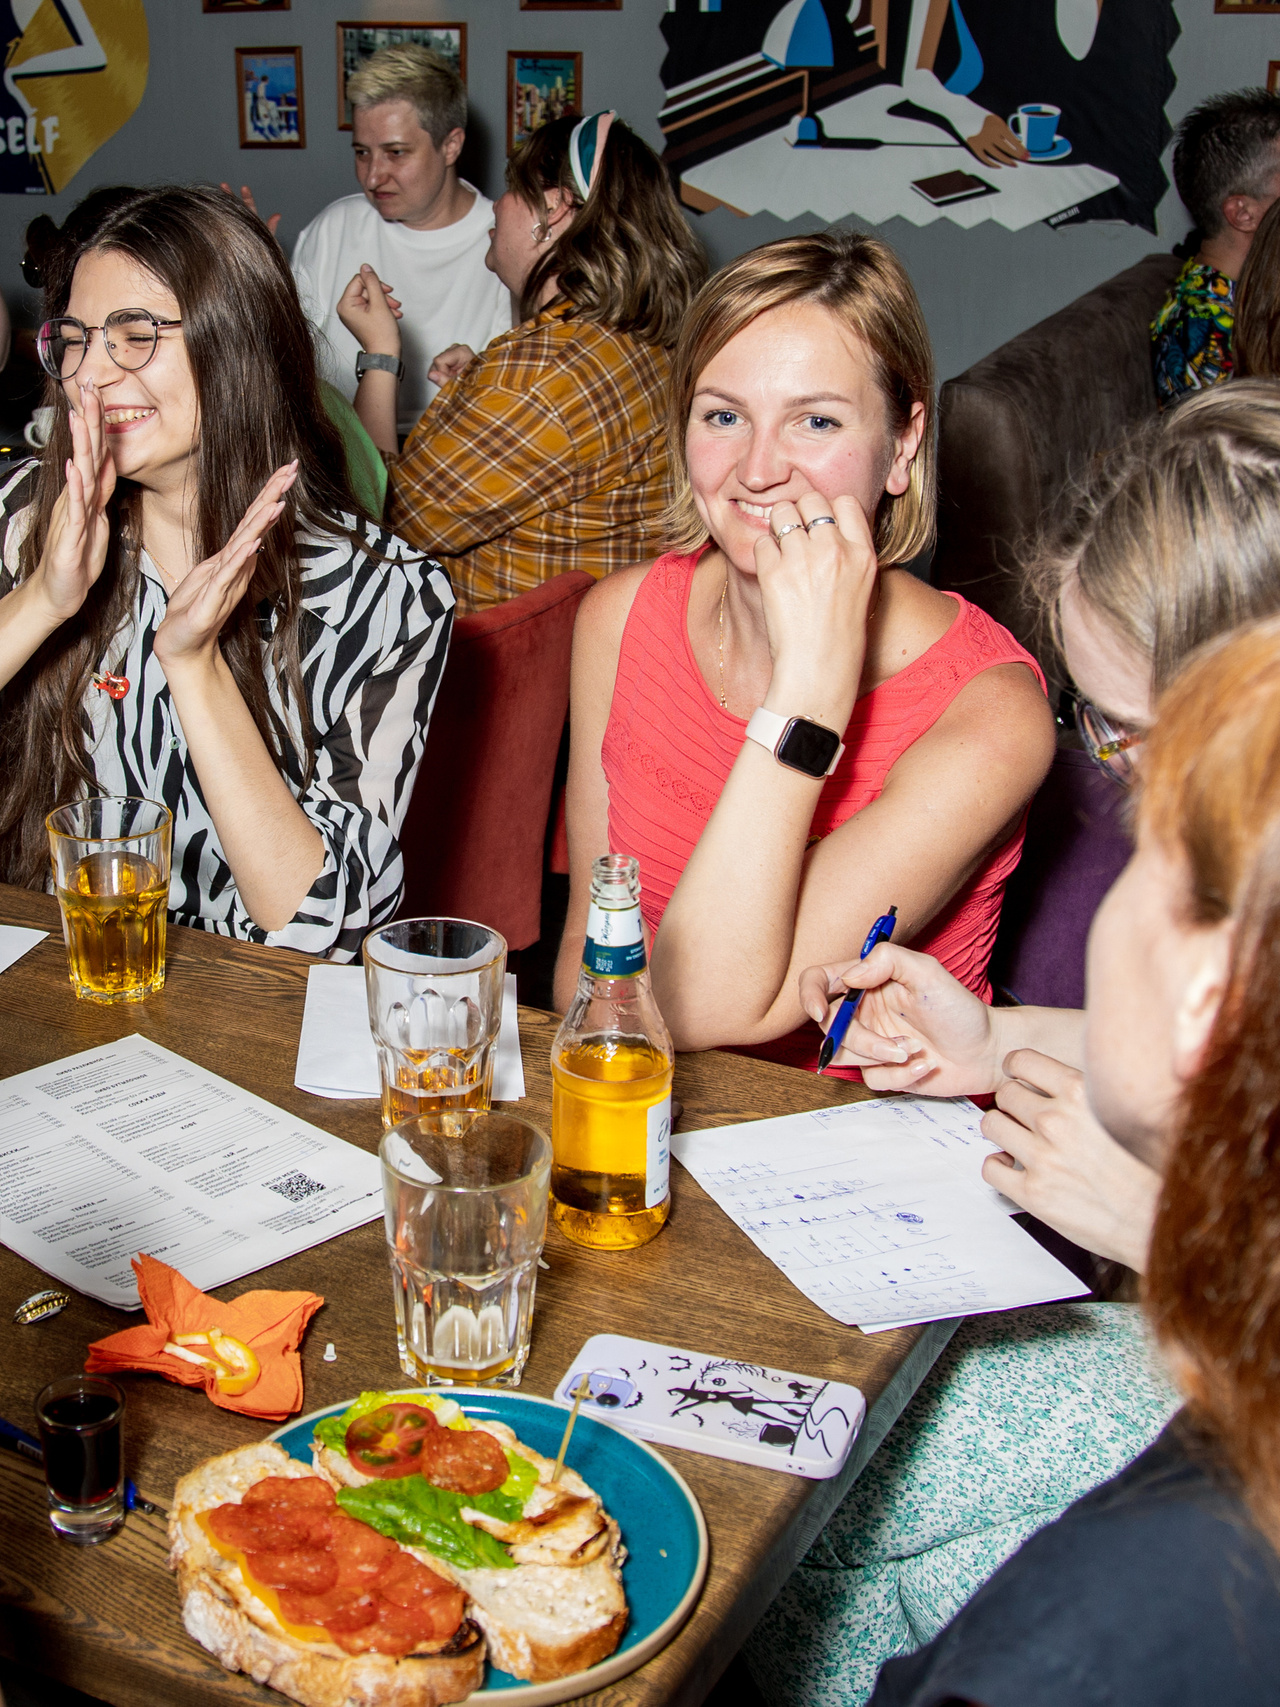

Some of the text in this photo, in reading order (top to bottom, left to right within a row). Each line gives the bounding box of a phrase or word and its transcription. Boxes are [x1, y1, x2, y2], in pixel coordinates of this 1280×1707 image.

[127, 1099, 145, 1107] СОКИ
[148, 1091, 167, 1099] ВОДЫ
[179, 1121, 197, 1129] КОФЕ
[281, 1168, 298, 1177] MENU
[71, 1201, 95, 1212] ТЕКИЛА
[146, 1245, 168, 1257] РЕНДИ
